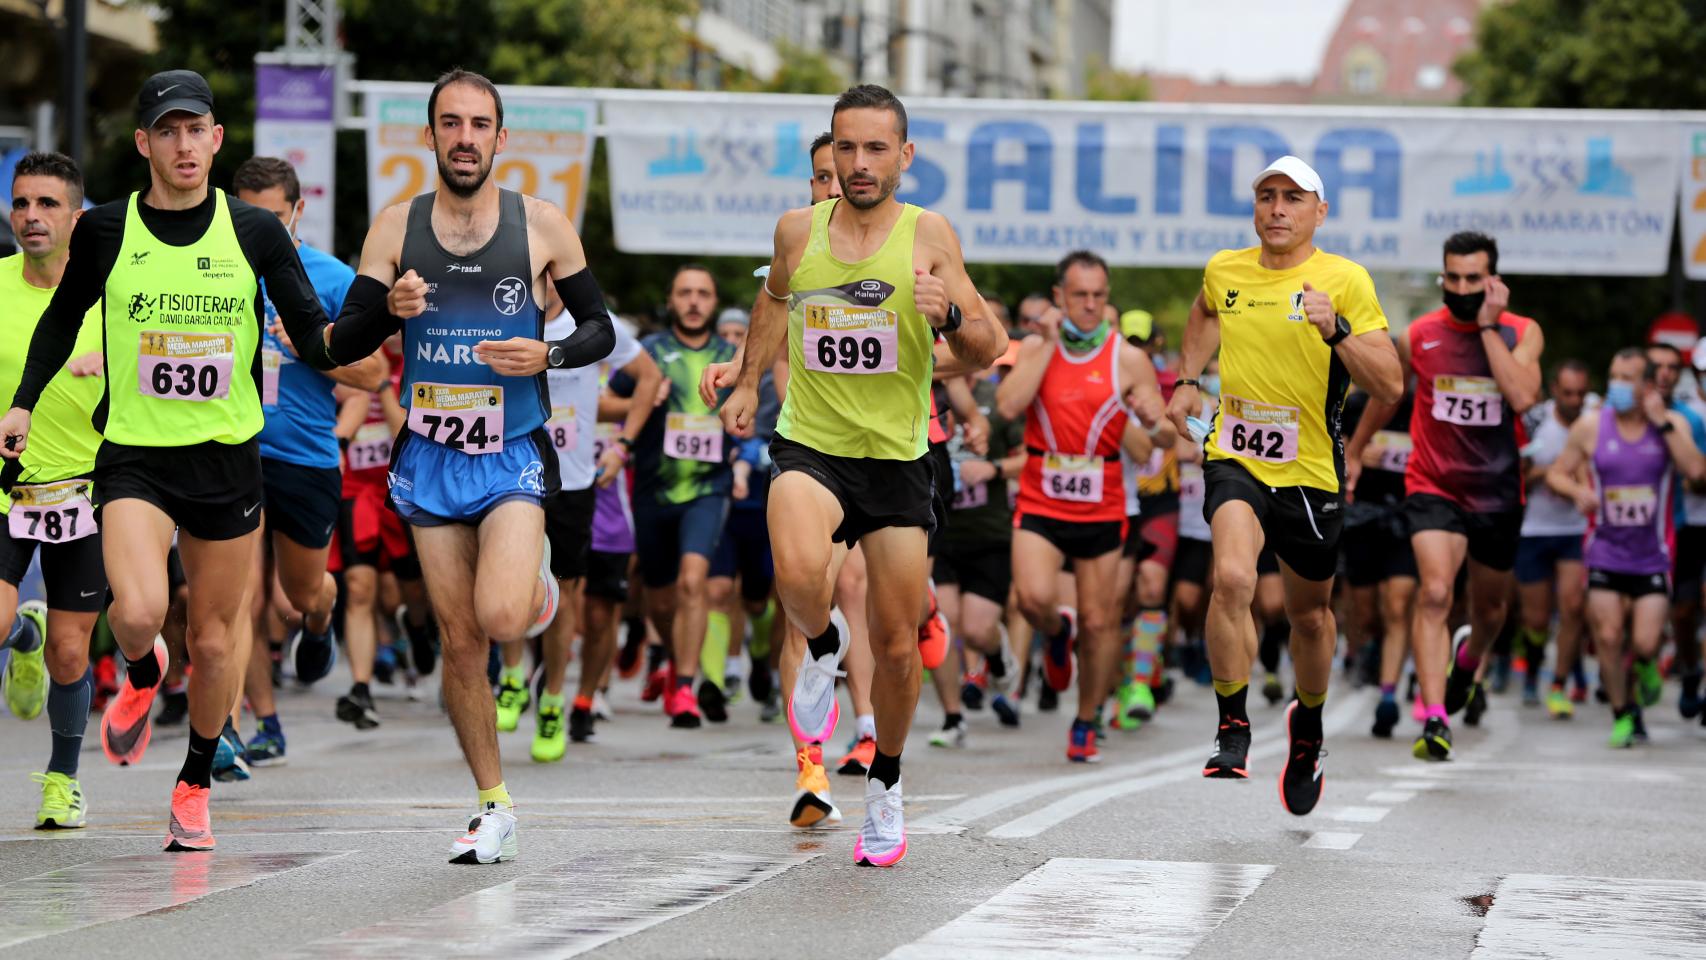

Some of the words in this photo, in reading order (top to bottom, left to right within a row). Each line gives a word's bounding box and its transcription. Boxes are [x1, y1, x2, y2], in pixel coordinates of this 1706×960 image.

[1424, 210, 1513, 231] MEDIA
[1522, 206, 1664, 234] MARATÓN
[974, 222, 1117, 252] MARATÓN
[1130, 226, 1146, 250] Y
[202, 271, 235, 279] deportes
[159, 293, 246, 313] FISIOTERAPA
[159, 313, 183, 324] DAVID
[184, 313, 212, 326] GARCÍA
[166, 341, 191, 351] MEDIA
[191, 336, 226, 349] MARATÓN
[426, 327, 448, 336] CLUB
[449, 328, 502, 337] ATLETISMO
[817, 335, 882, 369] 699
[151, 362, 219, 398] 630
[435, 394, 457, 403] MEDIA
[457, 388, 494, 402] MARATÓN
[1445, 397, 1488, 421] 751
[422, 414, 489, 450] 724
[1231, 423, 1285, 459] 642
[675, 434, 713, 456] 691
[1051, 474, 1092, 496] 648
[23, 507, 79, 540] 787
